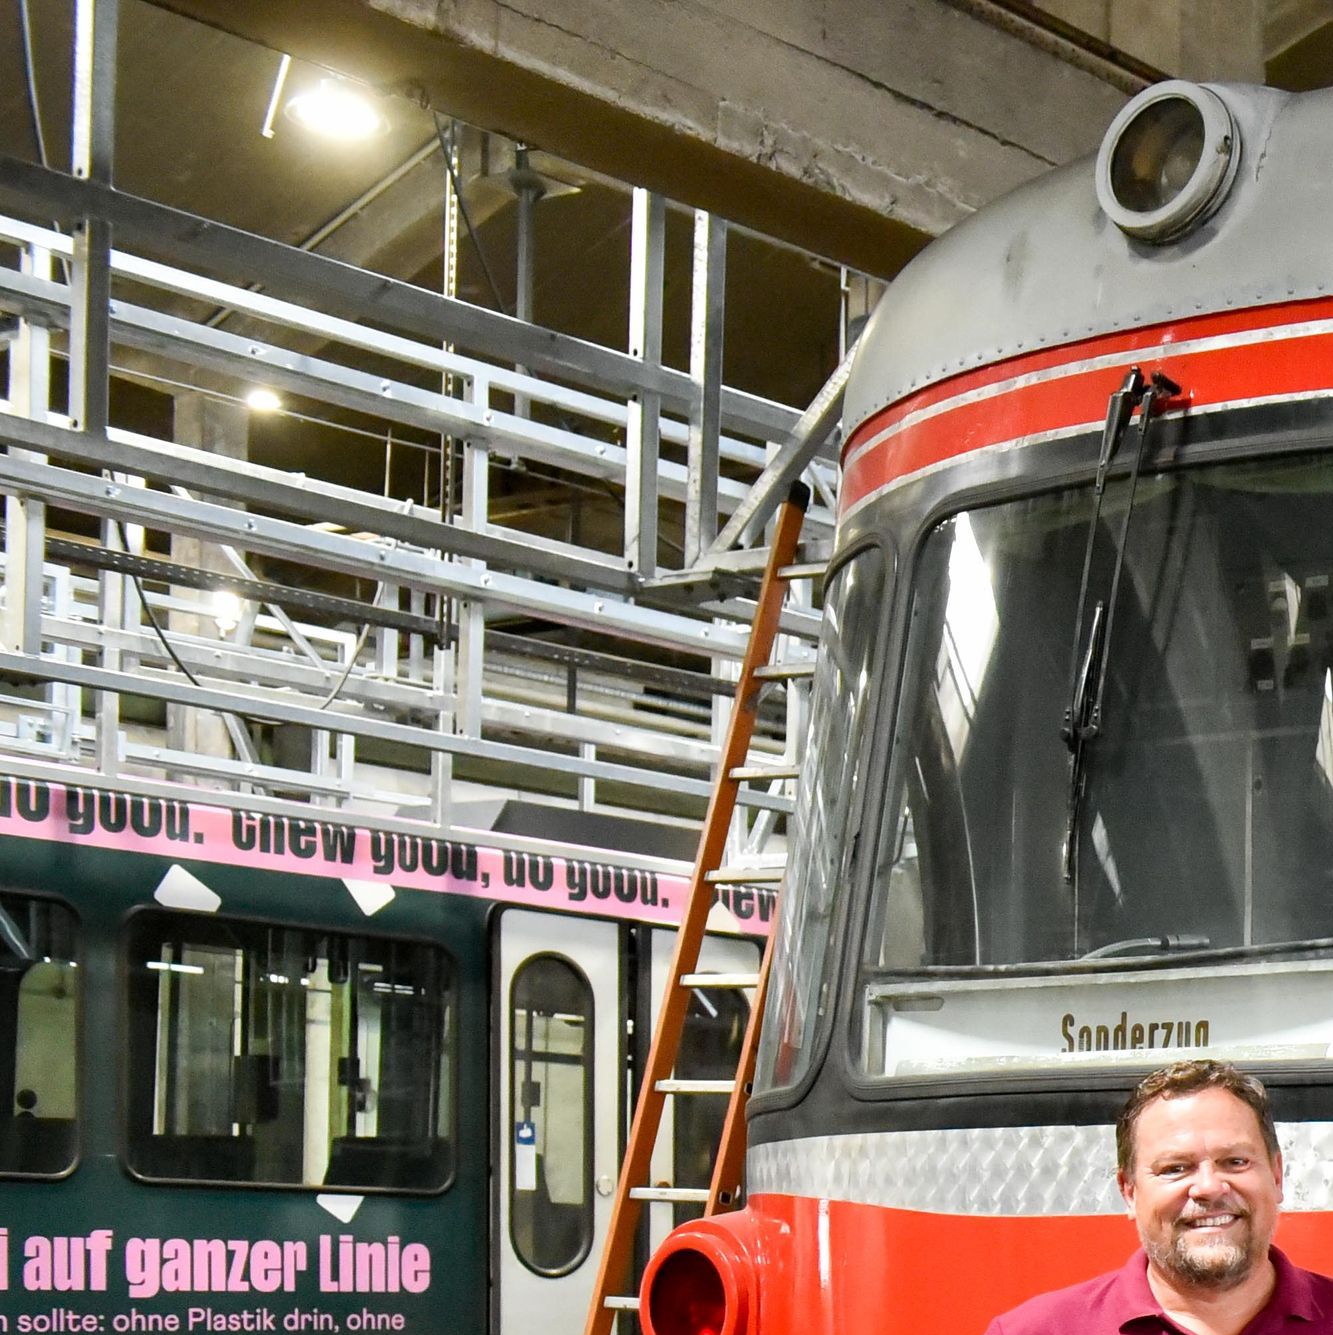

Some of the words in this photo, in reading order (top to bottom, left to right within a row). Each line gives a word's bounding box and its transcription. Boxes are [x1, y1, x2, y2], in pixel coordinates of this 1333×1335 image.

[23, 1229, 114, 1292] auf
[125, 1237, 308, 1299] ganzer
[319, 1234, 431, 1294] Linie
[17, 1307, 105, 1333] sollte:
[112, 1307, 180, 1333] ohne
[188, 1307, 277, 1332] Plastik
[283, 1306, 340, 1334] drin,
[346, 1307, 406, 1331] ohne
